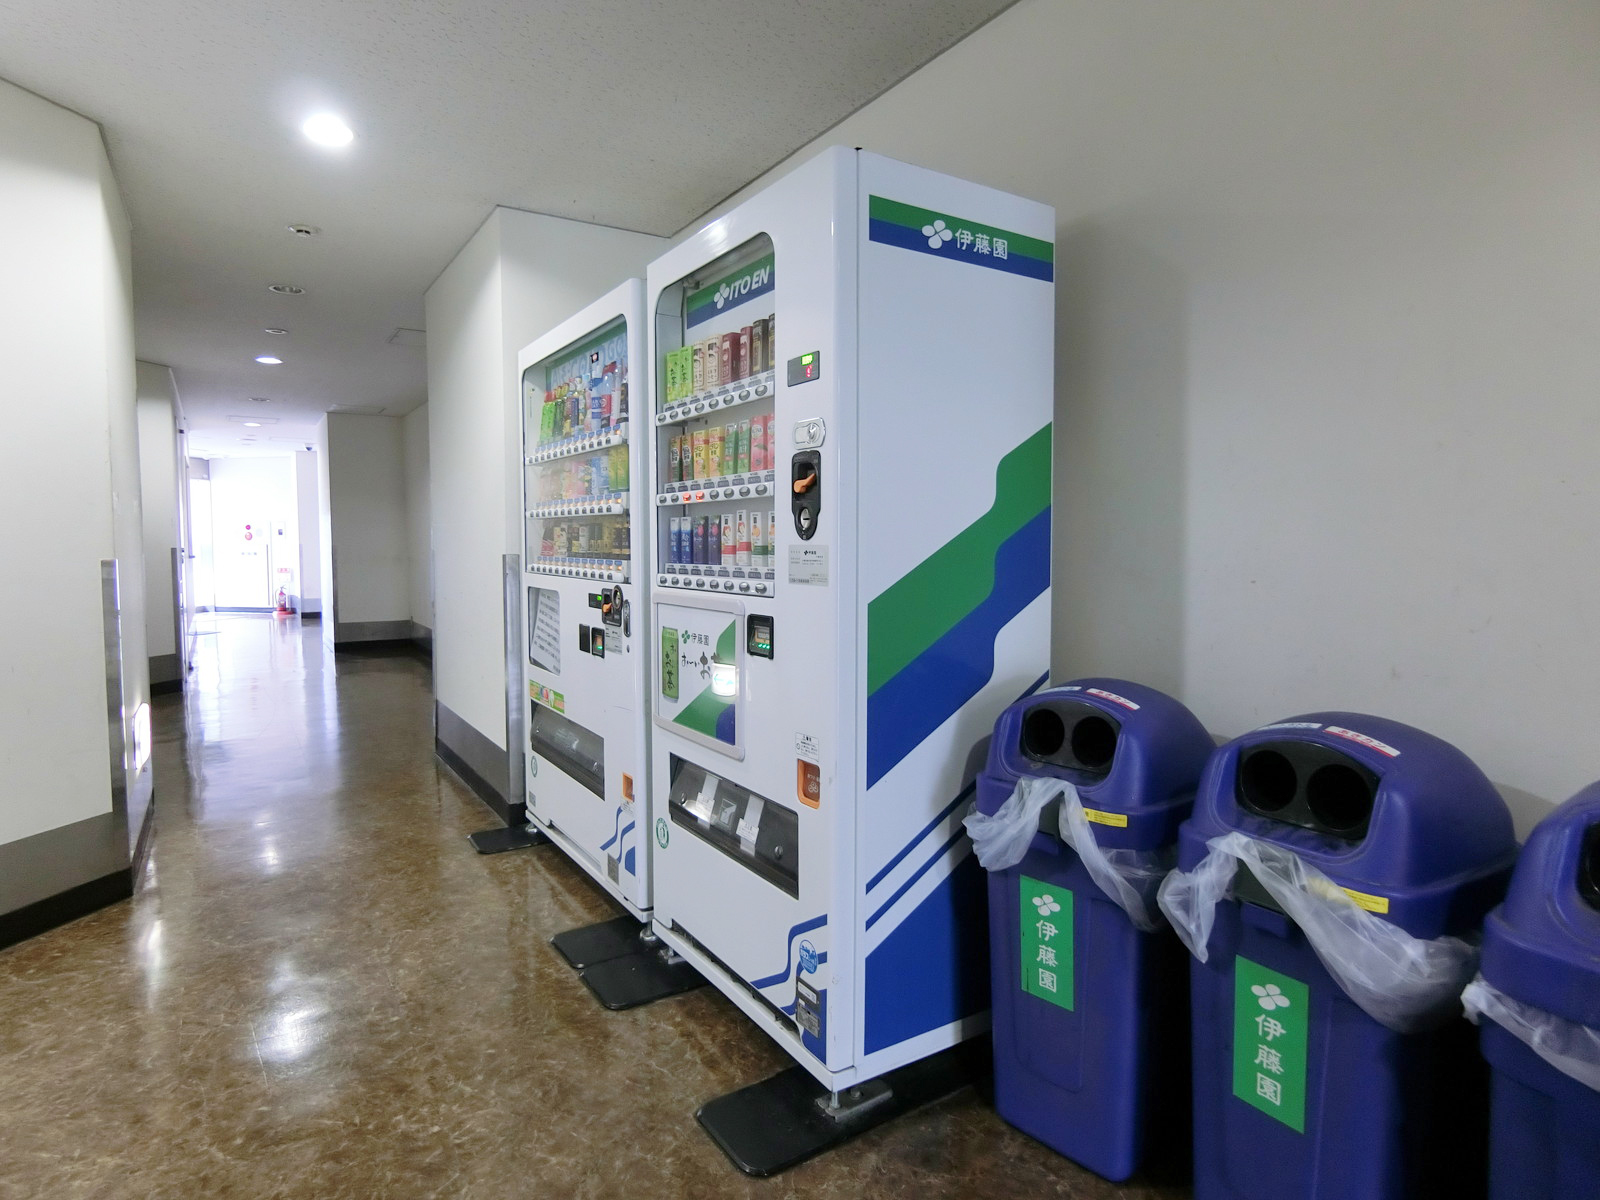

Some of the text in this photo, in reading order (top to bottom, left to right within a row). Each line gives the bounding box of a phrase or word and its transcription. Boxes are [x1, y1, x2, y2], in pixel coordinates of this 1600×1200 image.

[955, 228, 1008, 260] 伊藤園
[729, 265, 770, 301] ITO EN
[1036, 920, 1058, 993] 伊藤園
[1254, 1013, 1287, 1106] 伊藤園
